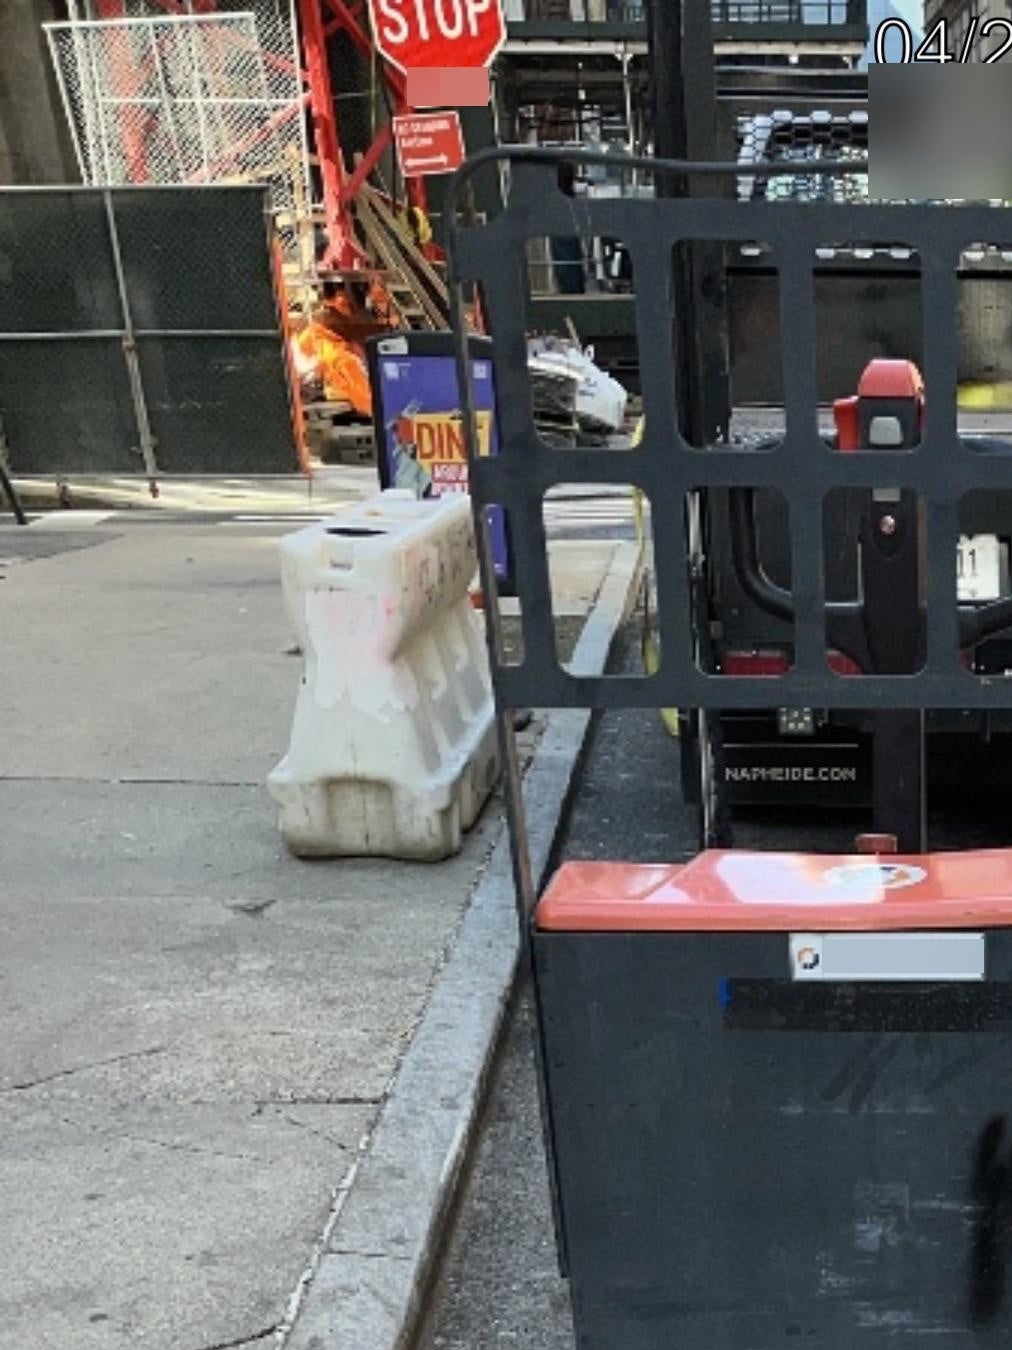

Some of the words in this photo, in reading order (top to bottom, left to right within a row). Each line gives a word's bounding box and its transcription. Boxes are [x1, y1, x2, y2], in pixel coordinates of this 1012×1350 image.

[379, 0, 490, 43] STOP
[415, 421, 482, 460] DIN
[724, 767, 857, 781] NAPHEIDE.COM
